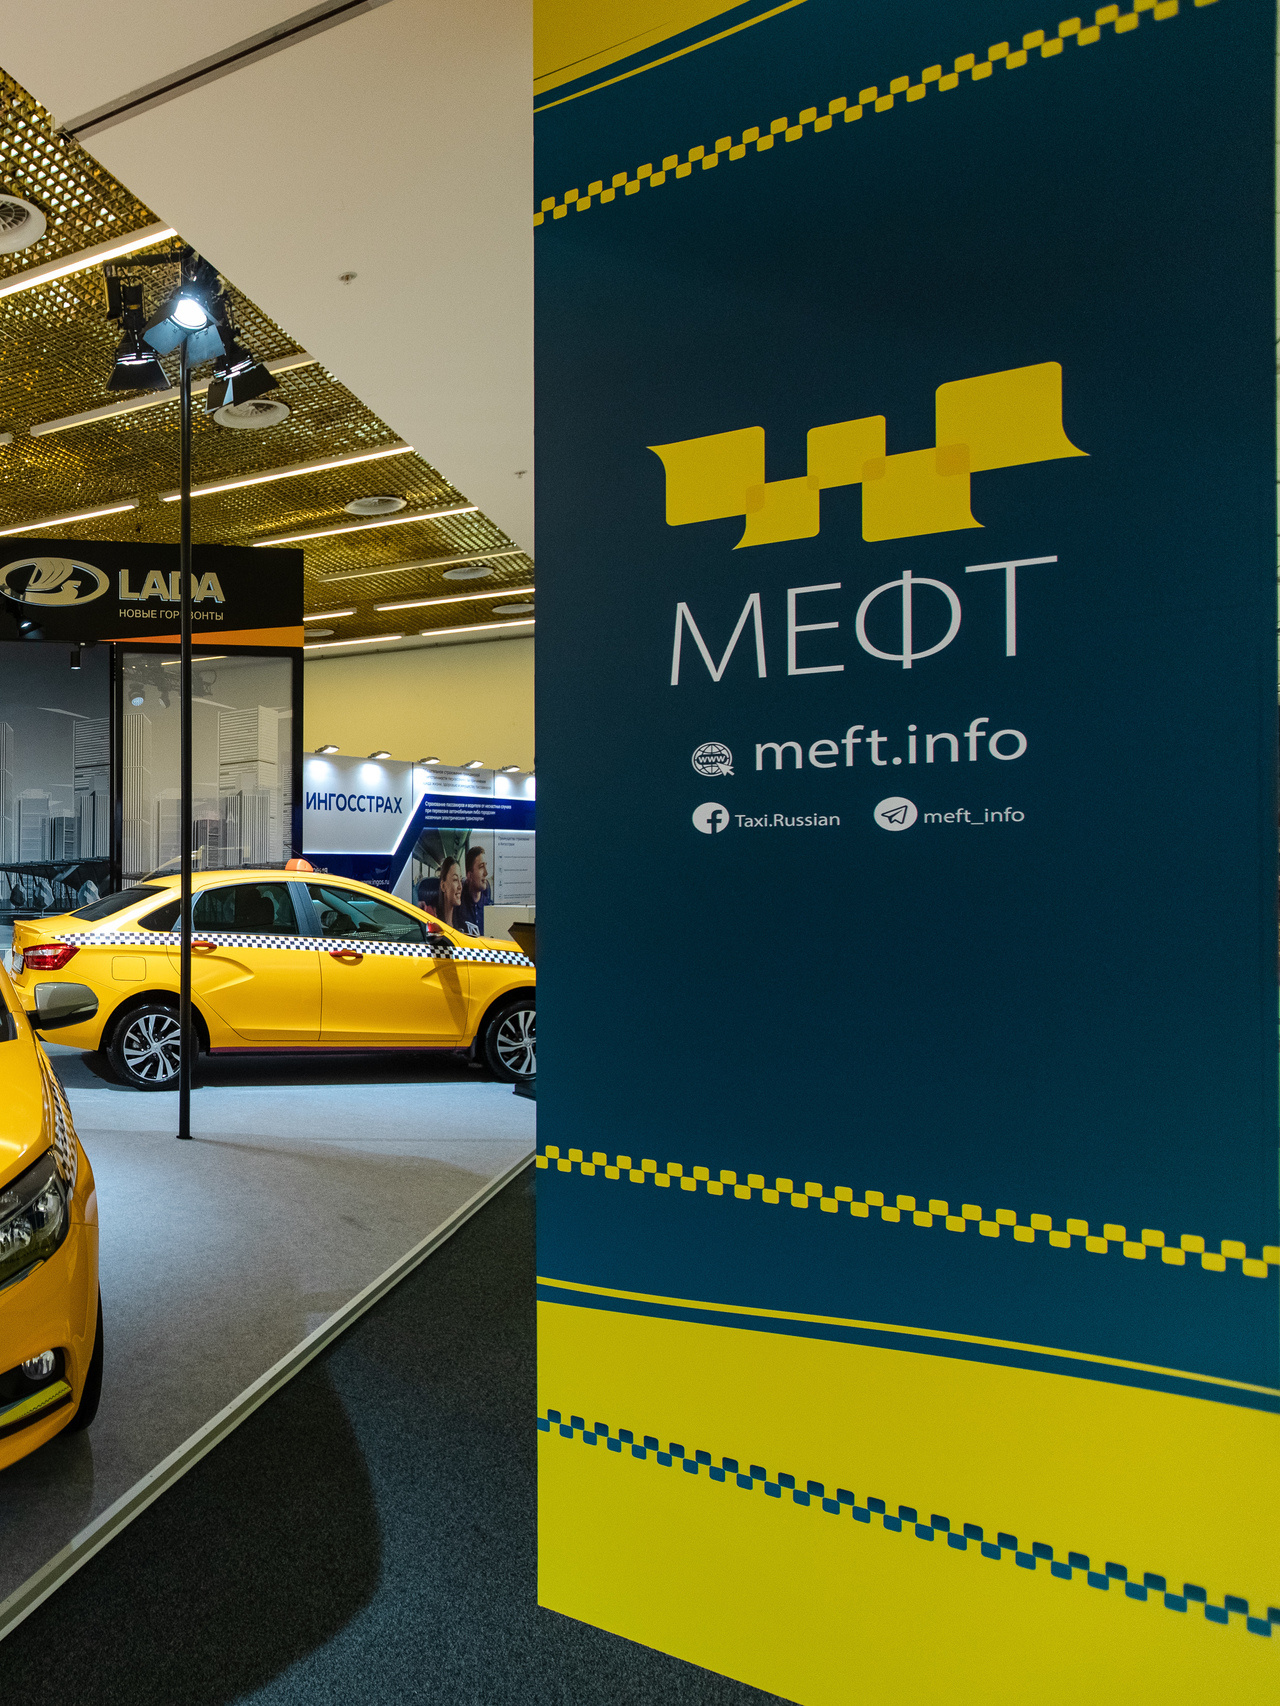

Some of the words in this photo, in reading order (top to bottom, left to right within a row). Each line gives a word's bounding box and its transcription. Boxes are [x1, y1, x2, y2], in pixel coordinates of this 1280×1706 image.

[118, 568, 226, 603] LADA
[119, 608, 158, 619] НОВЫЕ
[159, 609, 224, 621] ГОРЗОНТЫ
[670, 555, 1058, 686] МЕФТ
[698, 755, 726, 763] www
[754, 717, 1028, 771] meft.info
[306, 791, 403, 814] ИНГОССТРАХ
[734, 812, 841, 828] Taxi.Russian
[923, 806, 1025, 826] meft_info
